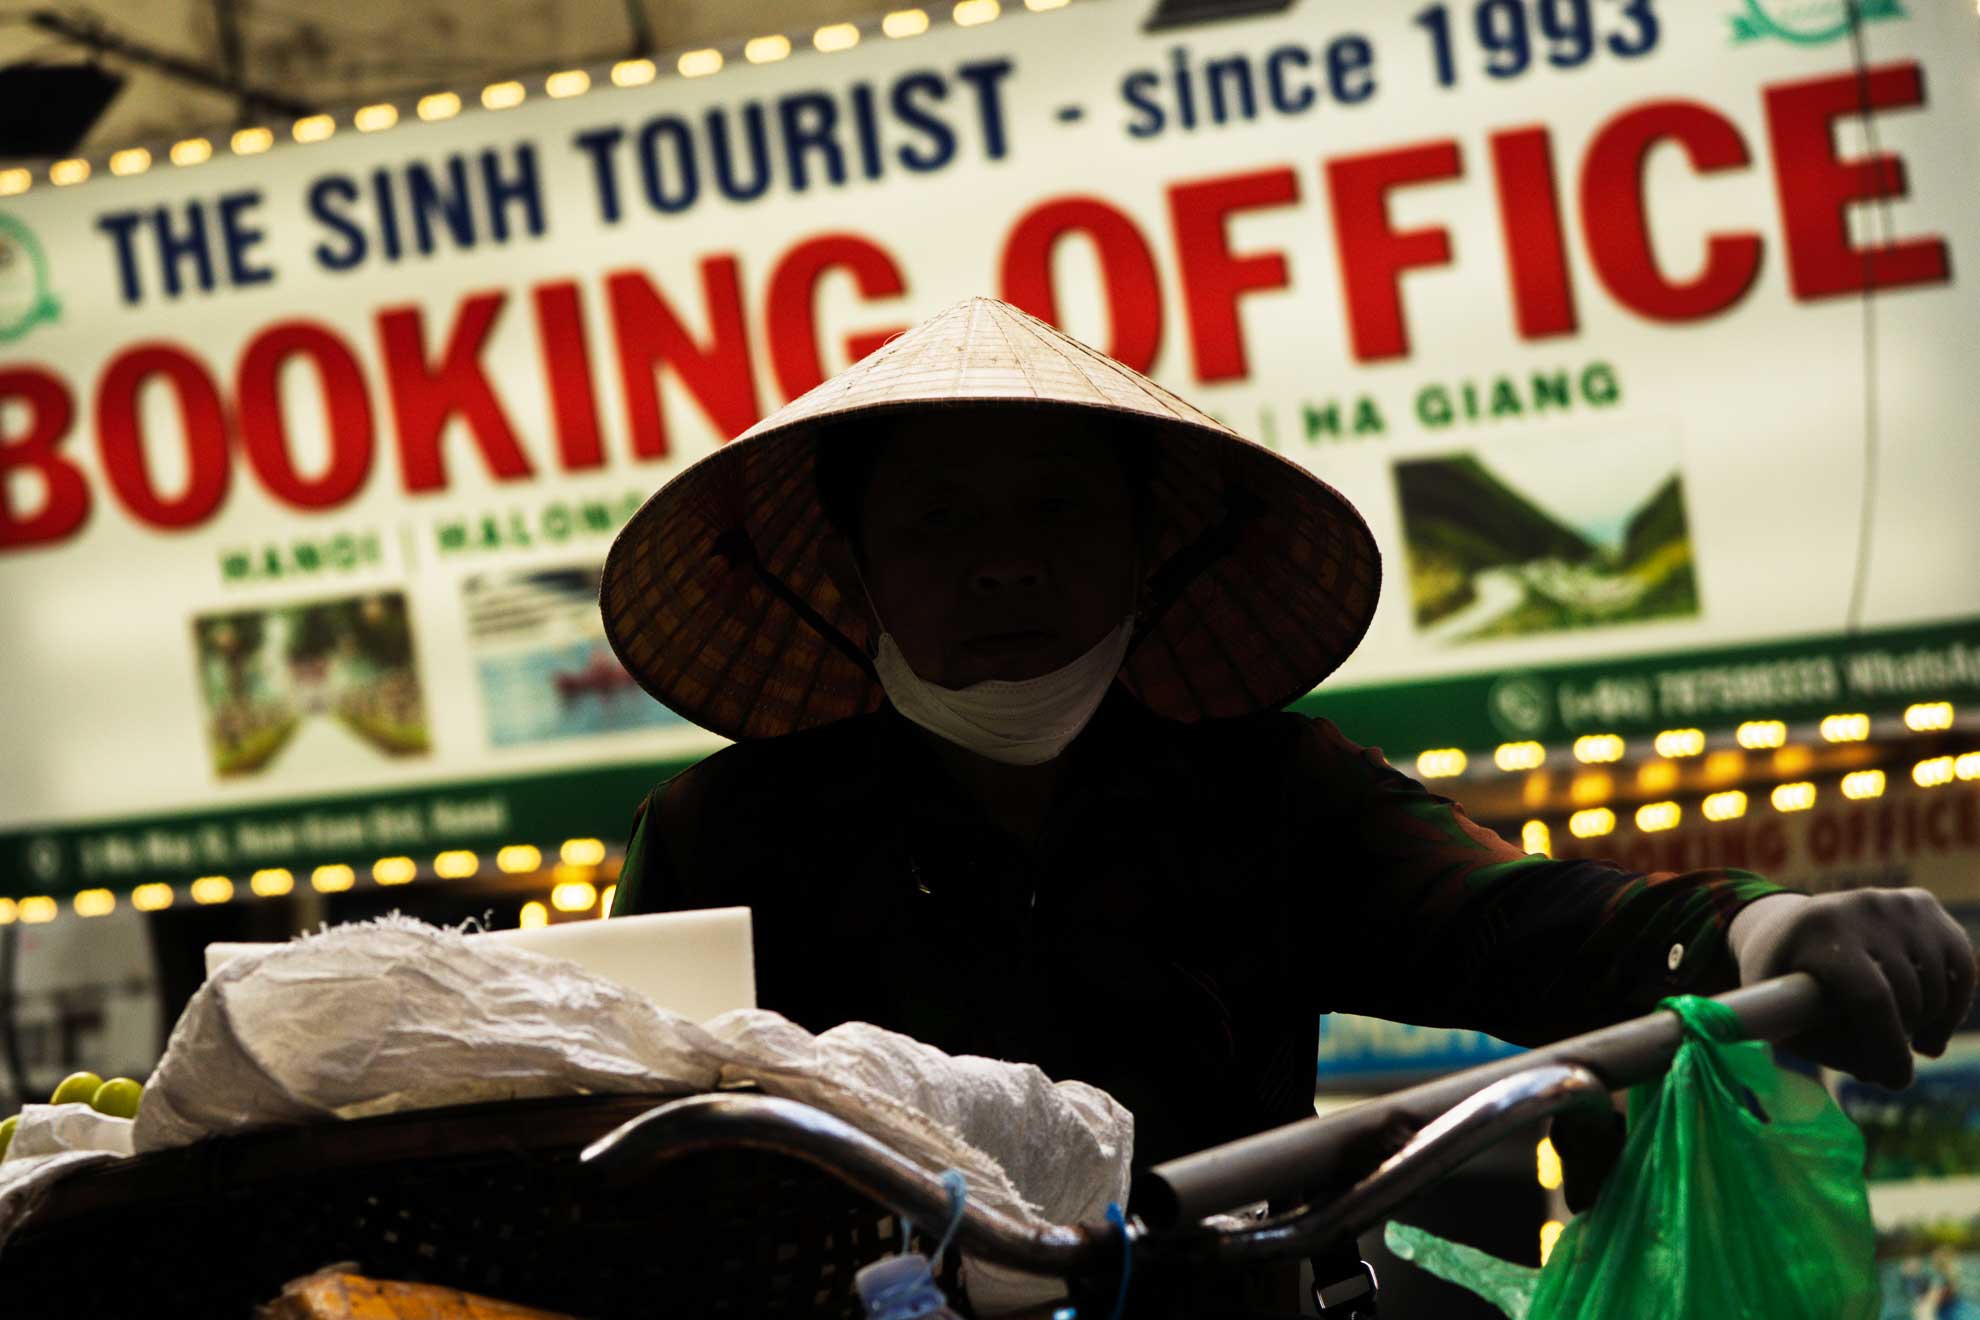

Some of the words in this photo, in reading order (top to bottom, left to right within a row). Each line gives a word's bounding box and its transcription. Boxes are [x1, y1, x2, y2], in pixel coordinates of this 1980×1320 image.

[0, 230, 909, 550] BOOKING
[996, 60, 1954, 386] OFFICE
[97, 190, 276, 306] THE
[306, 141, 547, 272] SINH
[573, 58, 1015, 224] TOURIST
[1121, 33, 1378, 138] since
[1412, 0, 1662, 88] 1993
[222, 532, 381, 582] HANOI
[1302, 396, 1388, 443] HA
[1415, 361, 1621, 429] GIANG
